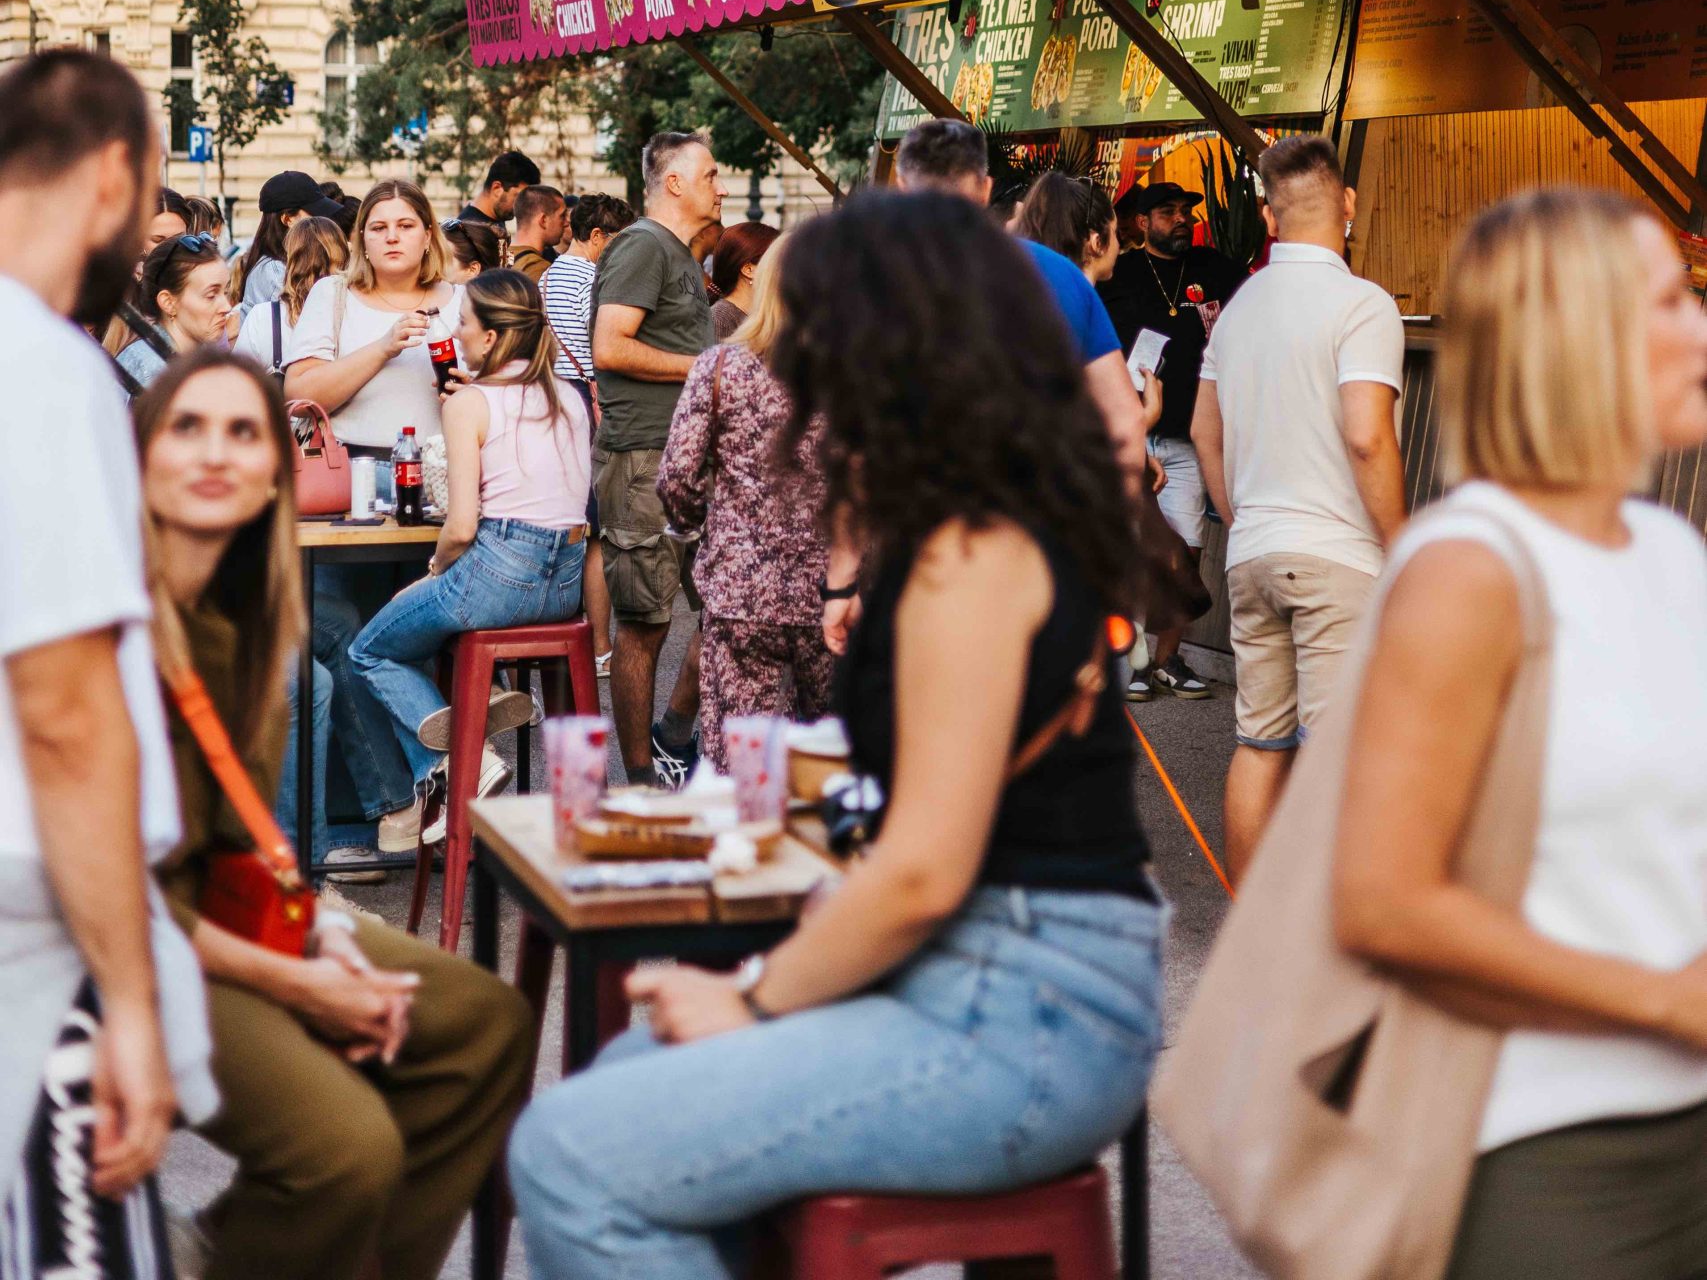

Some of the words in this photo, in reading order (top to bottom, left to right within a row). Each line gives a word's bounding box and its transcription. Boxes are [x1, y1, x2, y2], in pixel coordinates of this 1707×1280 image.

[479, 20, 499, 45] MARIO
[556, 0, 596, 38] CHICKEN
[905, 7, 955, 65] TRES
[1078, 15, 1119, 53] PORK
[1163, 0, 1227, 41] SHRIMP
[975, 26, 1034, 64] CHICKEN
[1219, 66, 1236, 80] TRES
[1234, 64, 1253, 79] TACOS
[190, 131, 203, 157] P
